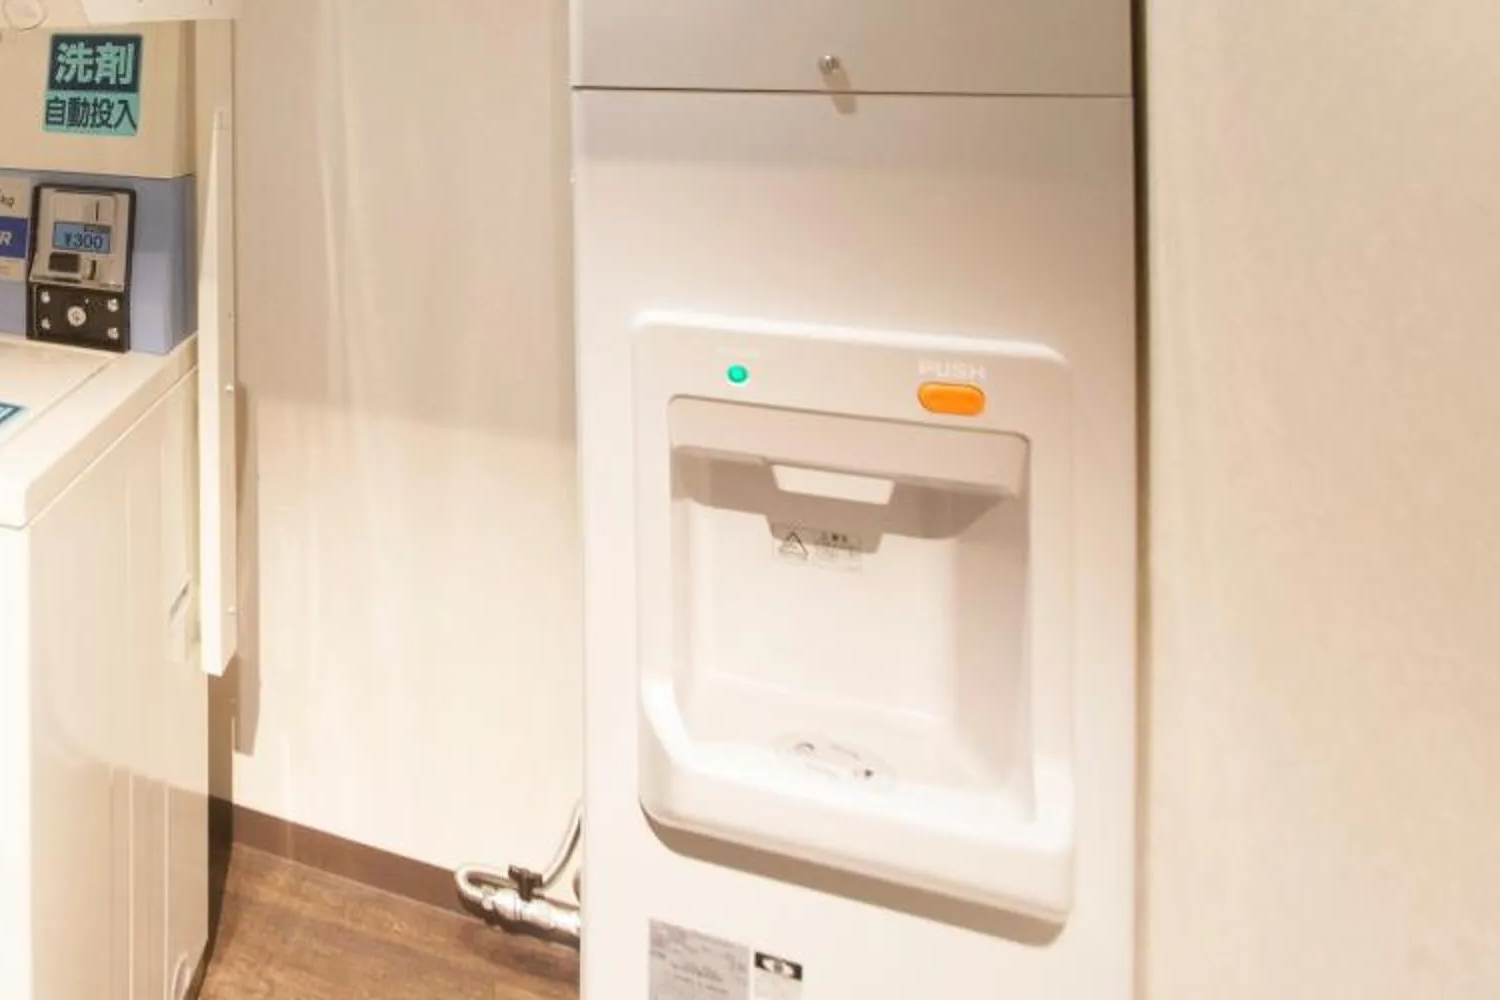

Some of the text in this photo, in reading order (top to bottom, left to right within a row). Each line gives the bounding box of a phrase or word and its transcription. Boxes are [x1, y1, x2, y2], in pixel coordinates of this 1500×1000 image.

[55, 40, 135, 86] 洗剤
[45, 95, 138, 131] 自動投入
[917, 358, 988, 381] PUSH
